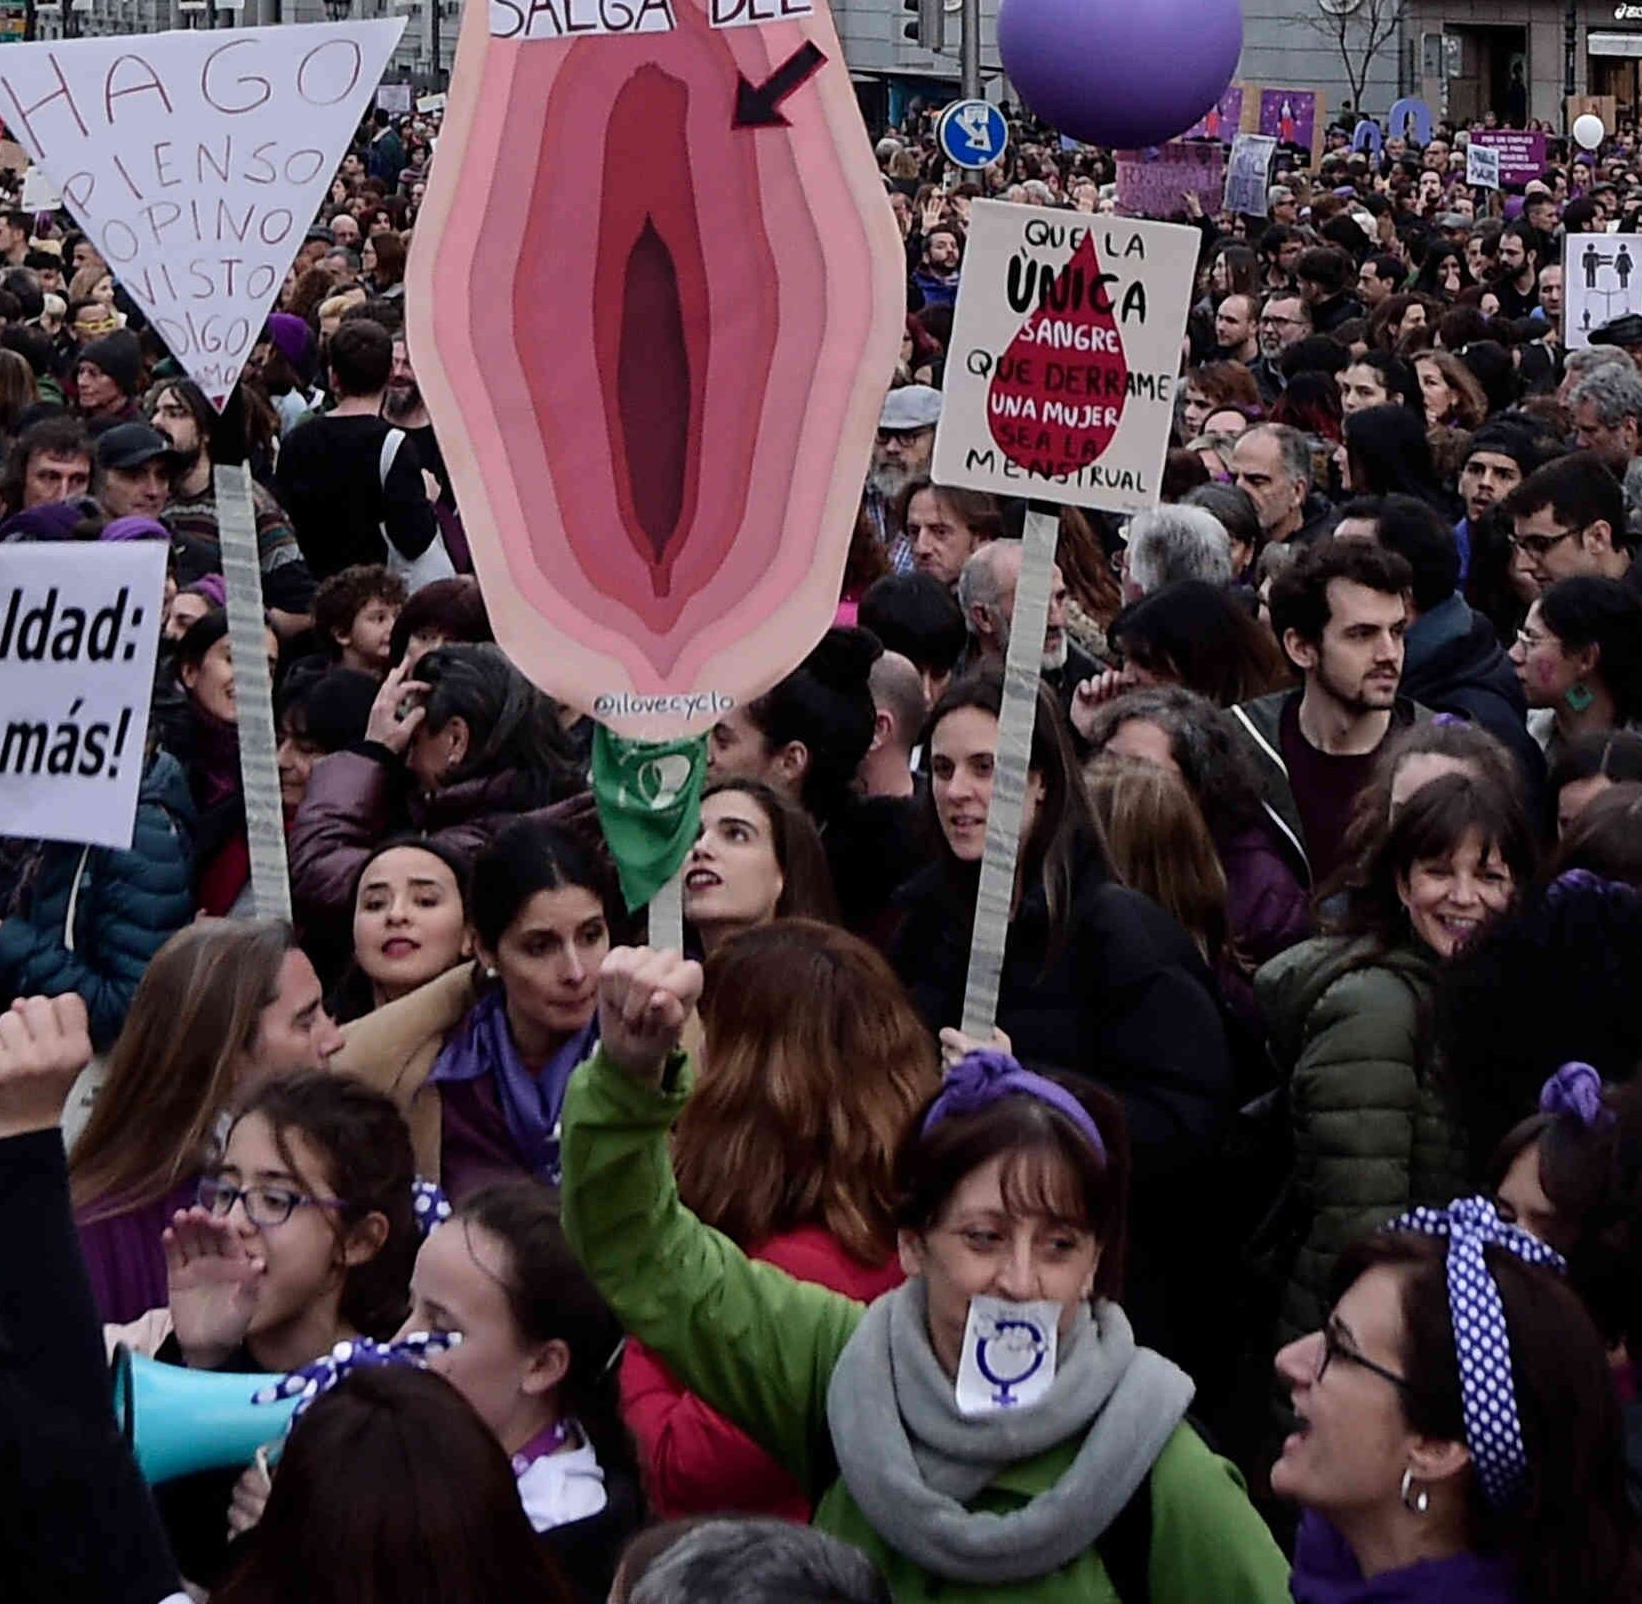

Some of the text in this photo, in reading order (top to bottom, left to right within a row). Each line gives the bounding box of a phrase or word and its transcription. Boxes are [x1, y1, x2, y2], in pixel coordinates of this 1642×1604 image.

[1, 39, 362, 159] HAGO
[63, 135, 325, 218] PIENSO
[101, 198, 294, 263] OPINO
[1025, 219, 1145, 260] QUE LA
[124, 257, 276, 305] VISTO
[156, 311, 250, 356] DIGO
[1018, 317, 1120, 353] SANGRE
[967, 349, 1171, 401] QUE DERRAME
[991, 393, 1118, 429] UNA MUJER
[997, 426, 1099, 458] SEA LA
[966, 449, 1147, 493] MENSTRUAL
[594, 691, 734, 720] @ilovecyclo
